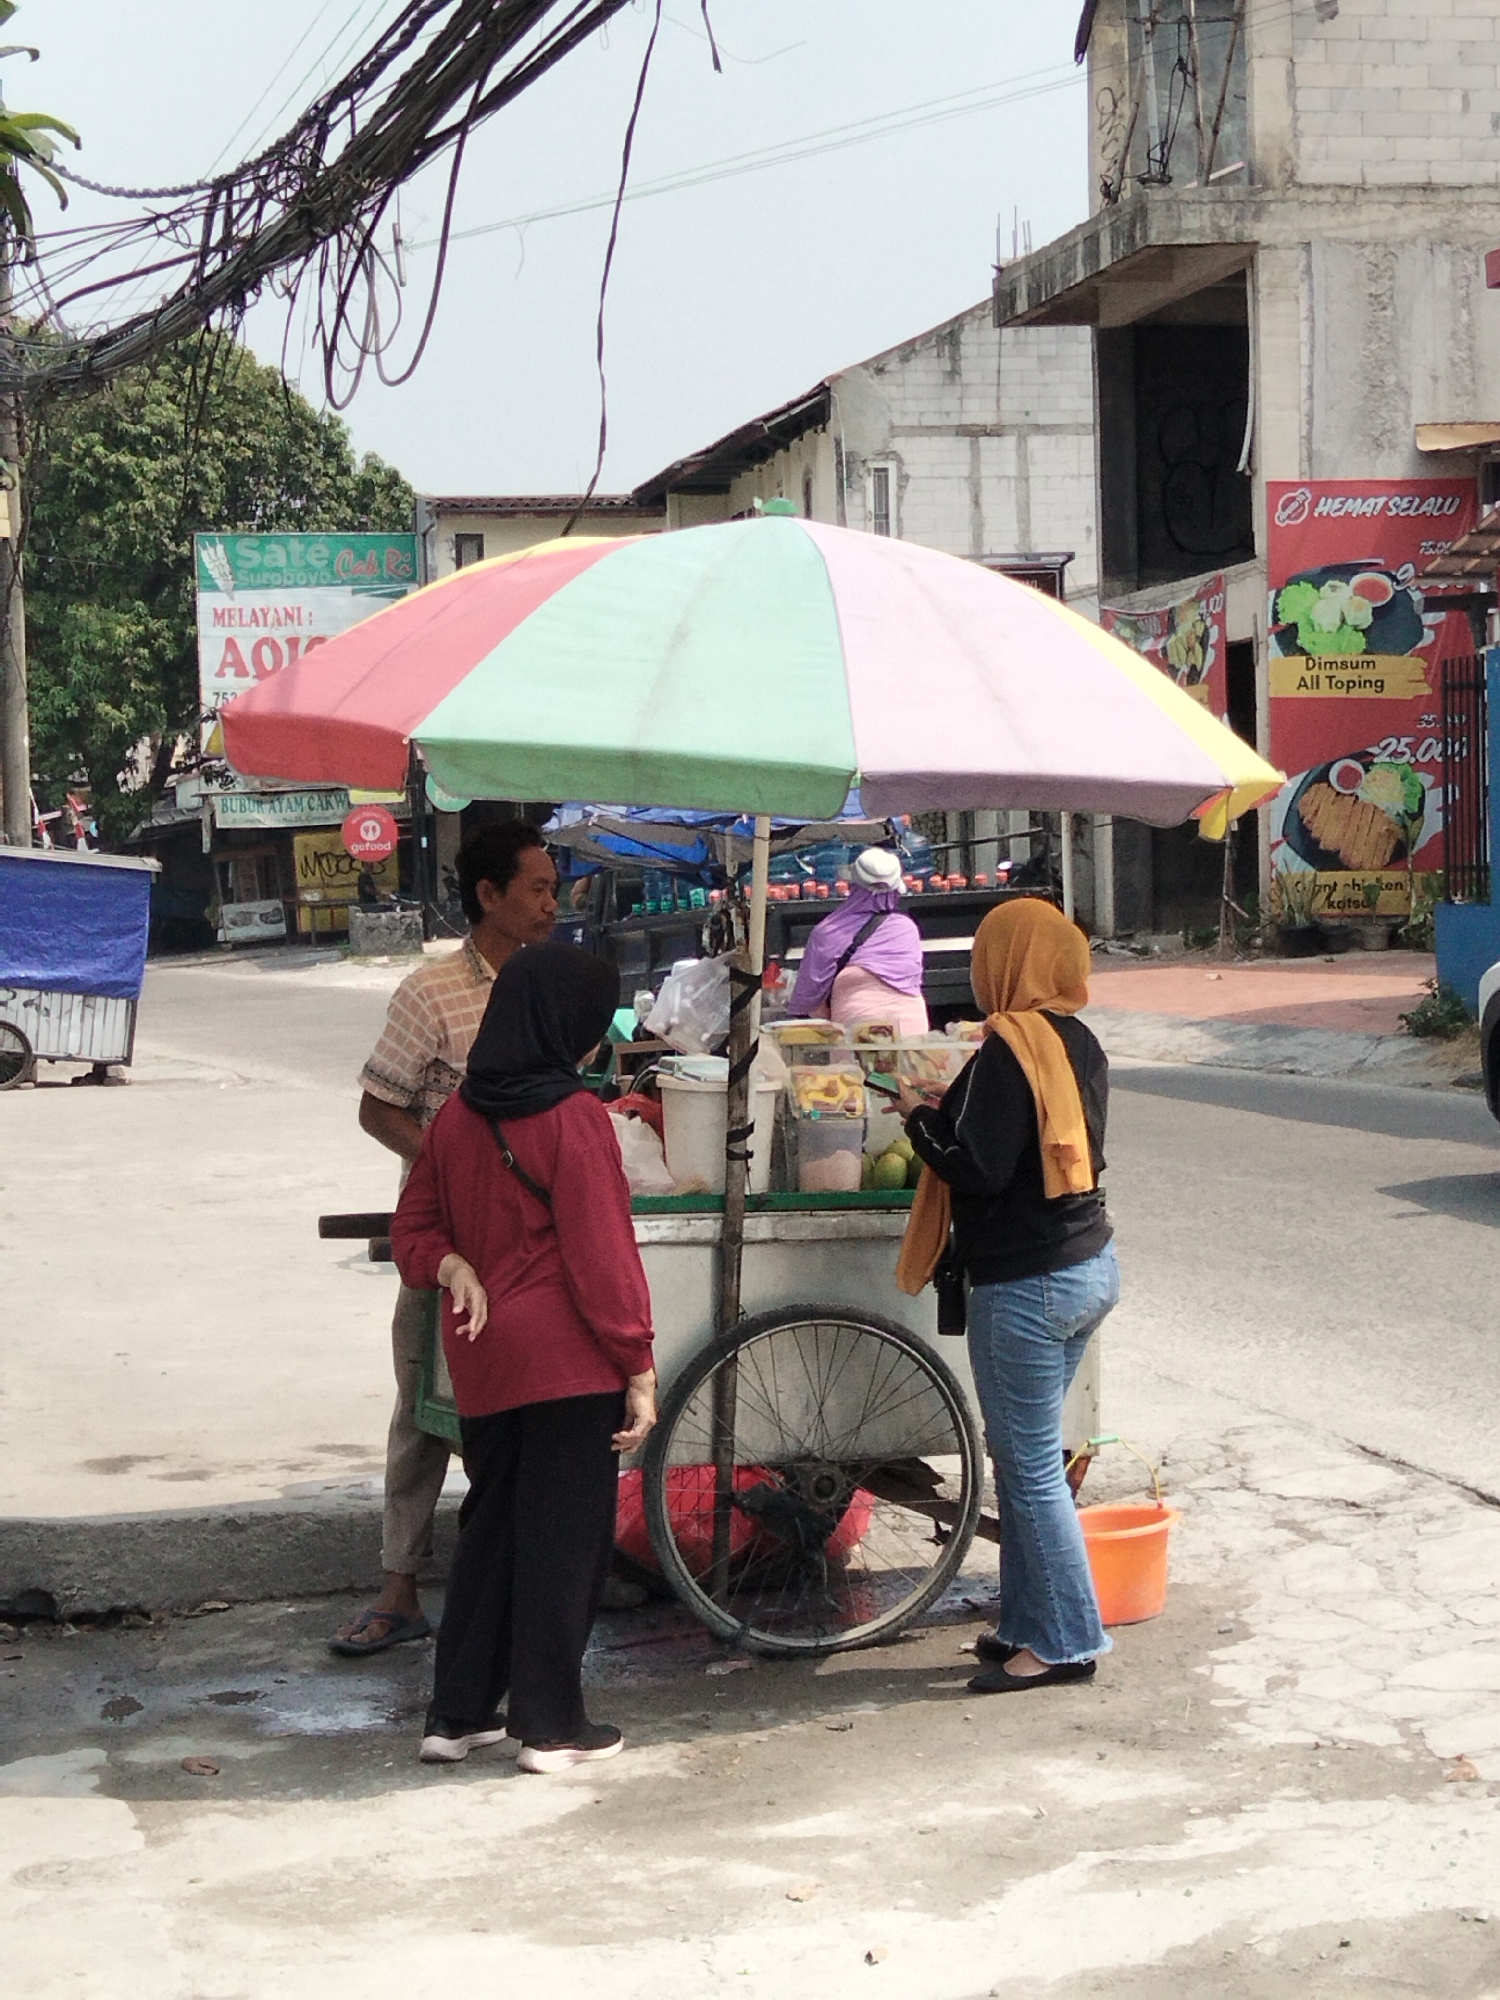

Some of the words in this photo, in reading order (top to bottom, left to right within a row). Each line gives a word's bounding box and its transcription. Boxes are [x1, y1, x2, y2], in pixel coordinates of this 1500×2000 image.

[1313, 496, 1388, 518] HEMAT
[1386, 496, 1461, 517] SELALU
[334, 549, 379, 578] Cak
[236, 569, 331, 586] Suroboyo
[212, 607, 303, 628] MELAYANI
[1305, 656, 1376, 671] Dimsum
[1296, 676, 1320, 690] All
[1325, 676, 1385, 693] Toping
[221, 797, 265, 814] BUBUR
[268, 797, 304, 814] AYAM
[351, 841, 392, 854] gofood
